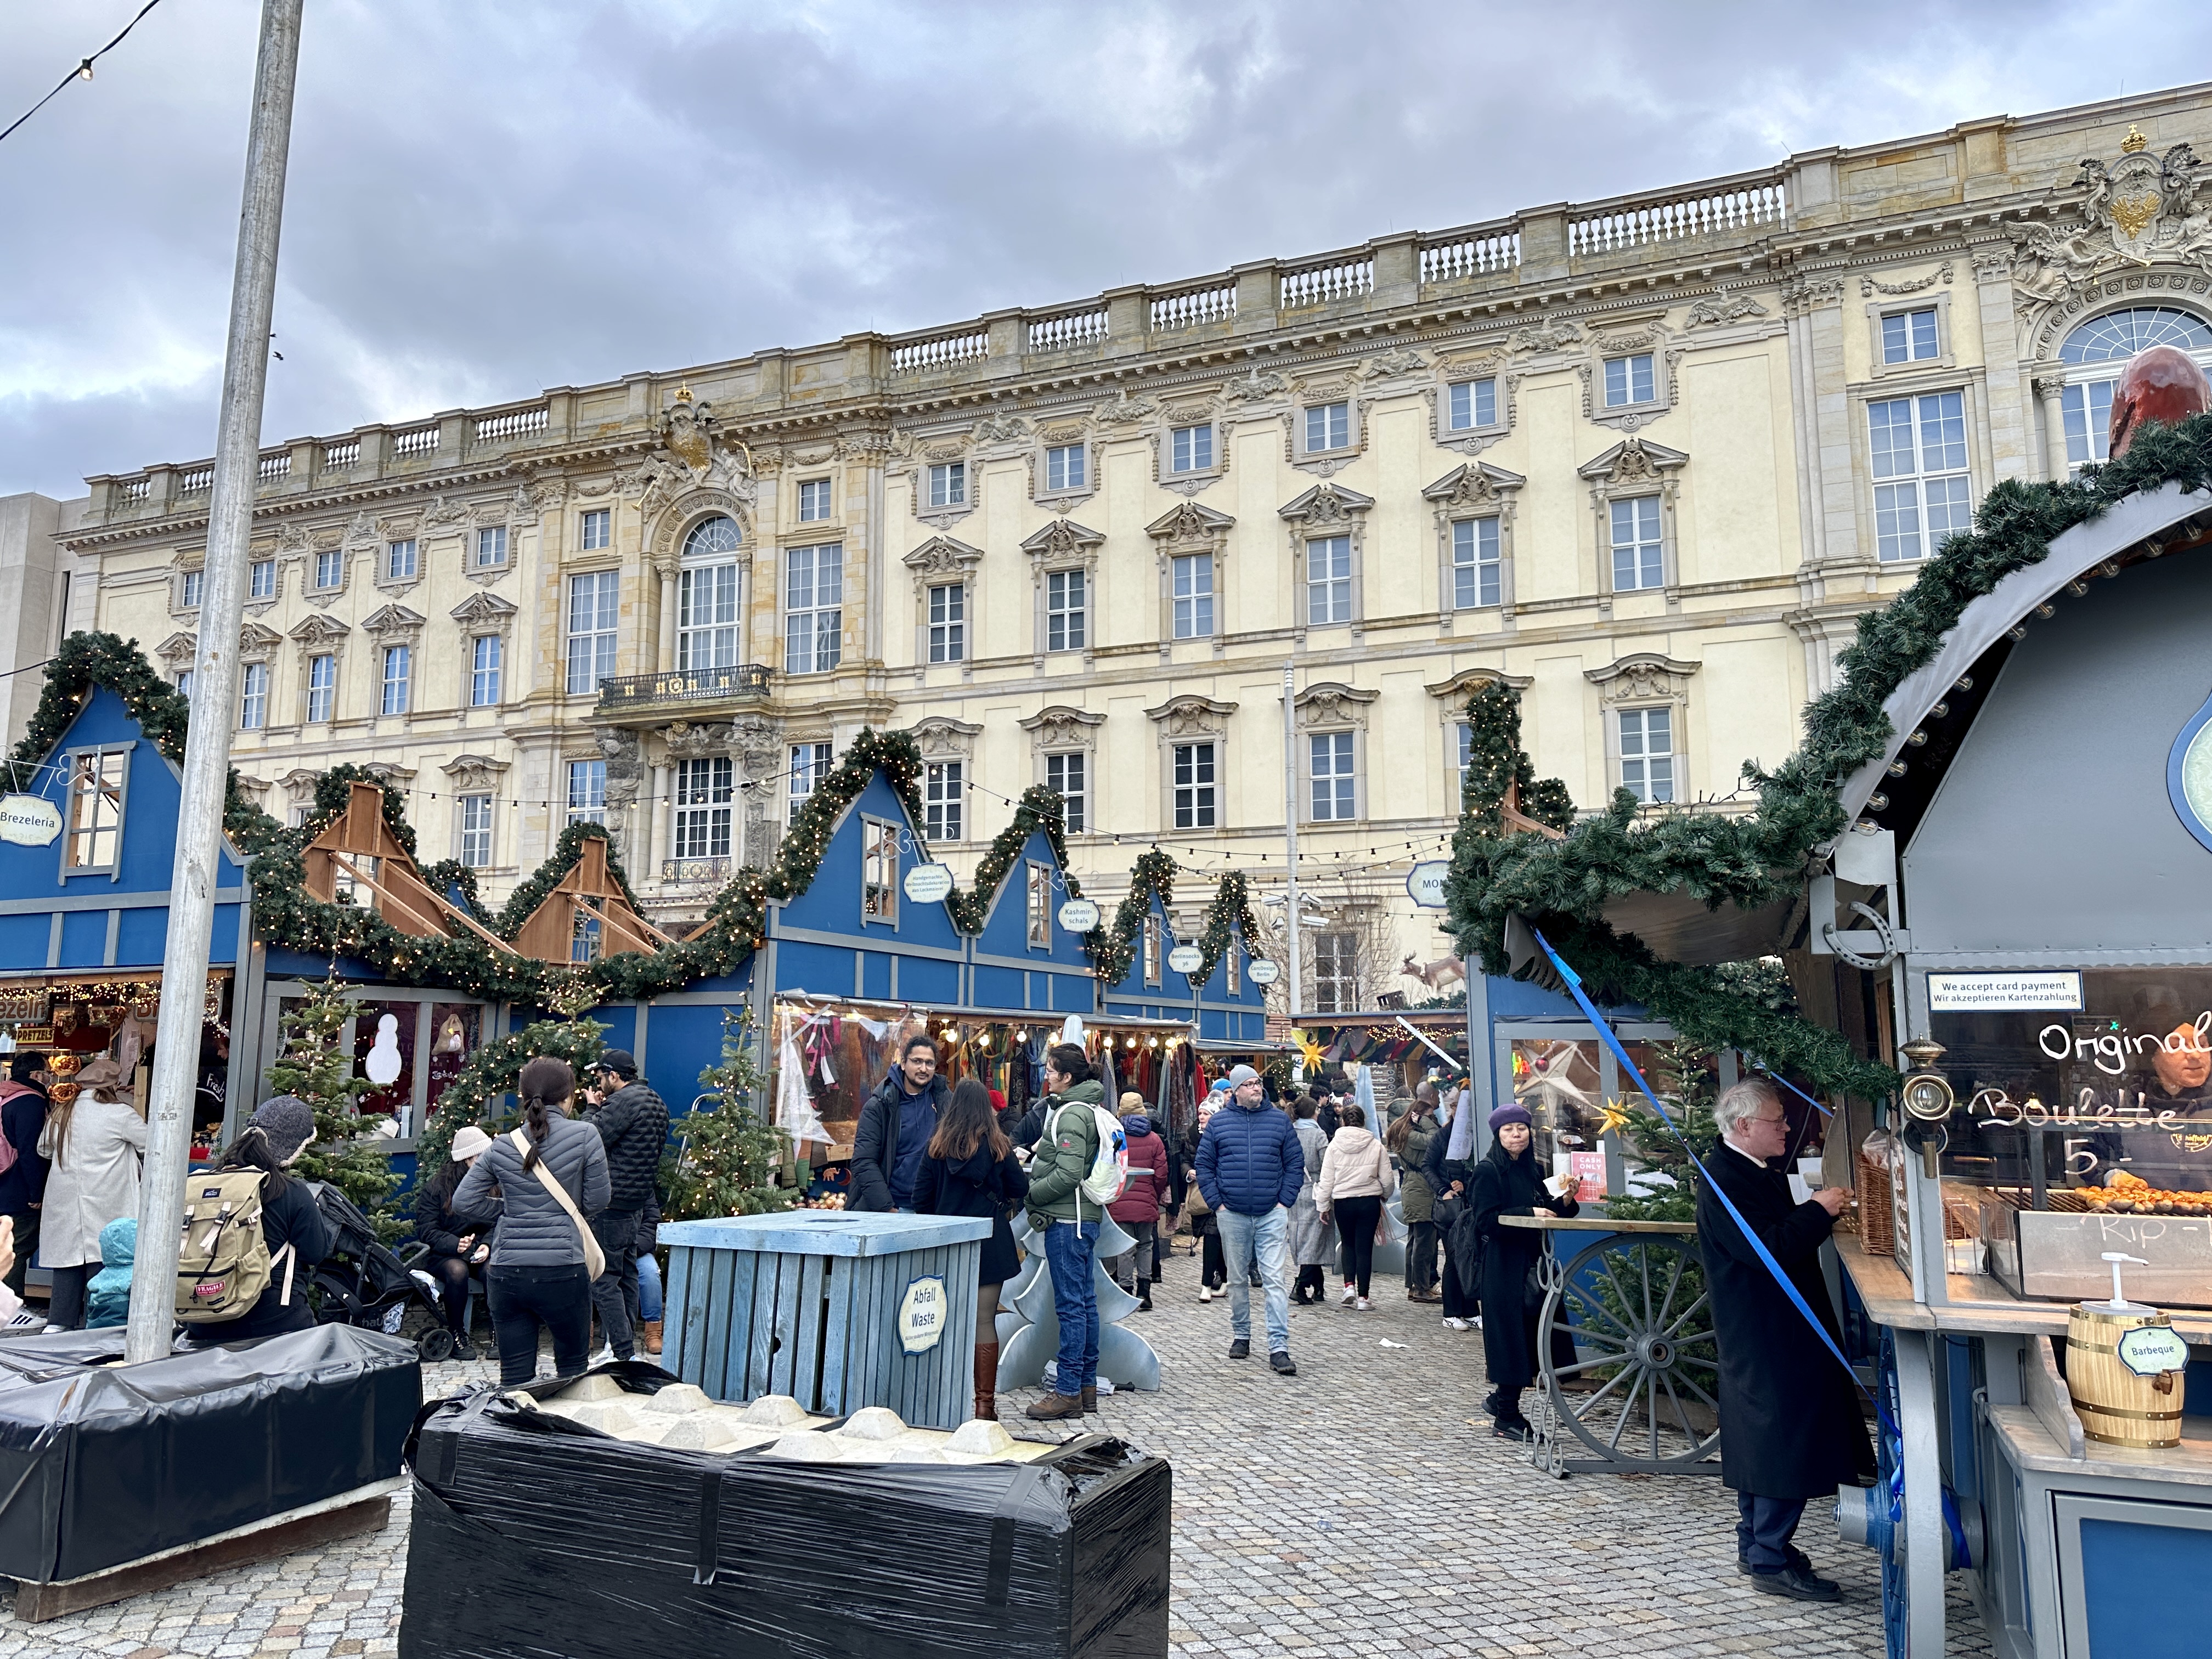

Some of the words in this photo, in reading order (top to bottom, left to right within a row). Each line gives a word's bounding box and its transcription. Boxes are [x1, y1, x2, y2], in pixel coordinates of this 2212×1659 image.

[1, 811, 54, 827] Brezeleria
[1942, 983, 1957, 991] We
[1960, 983, 1993, 992] accept
[1996, 981, 2018, 990] card
[2021, 981, 2066, 992] payment
[1951, 994, 2005, 1003] akzeptieren
[2008, 994, 2076, 1002] Kartenzahlung
[17, 1029, 53, 1041] PRETZELS
[2039, 1011, 2212, 1075] Original
[206, 1073, 225, 1097] Fresh
[1967, 1087, 2185, 1131] Boulette
[2064, 1138, 2098, 1175] 5
[198, 1283, 223, 1292] FRAGILE
[913, 1287, 936, 1305] Abfall
[912, 1311, 935, 1328] Waste
[2131, 1346, 2175, 1356] Barbeque
